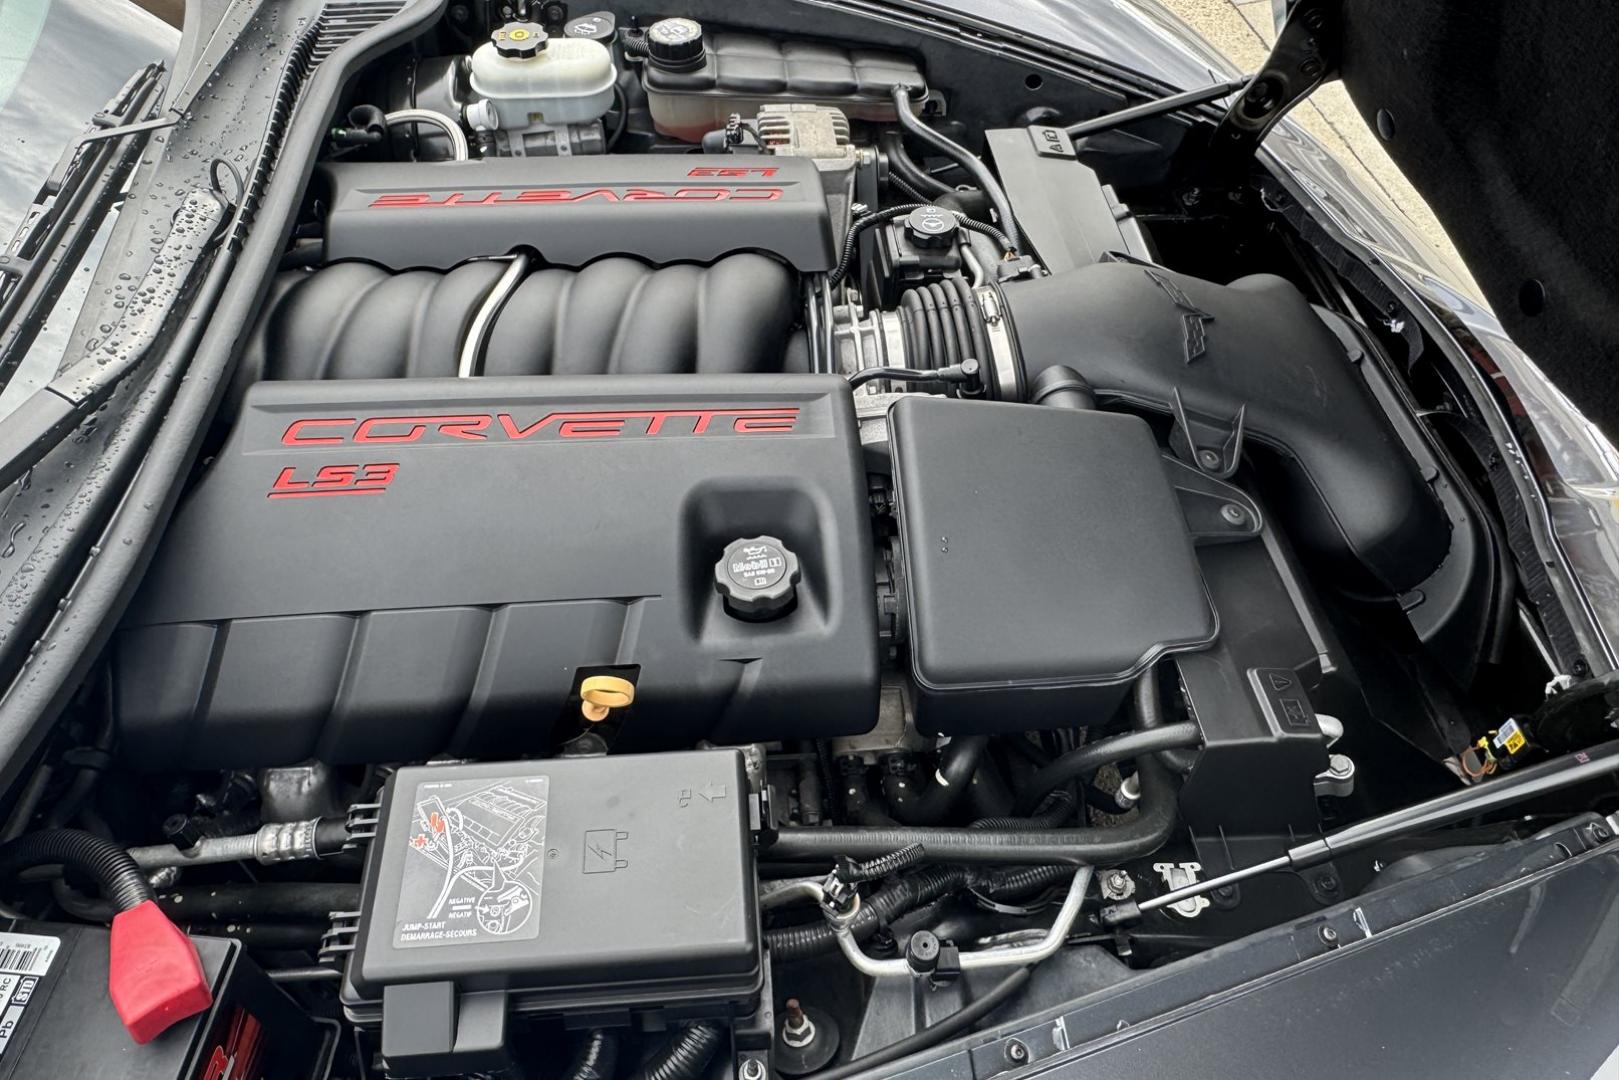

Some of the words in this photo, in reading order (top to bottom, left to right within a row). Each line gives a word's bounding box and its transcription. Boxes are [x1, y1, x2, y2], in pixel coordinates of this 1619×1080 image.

[368, 188, 784, 208] CORVETTE
[281, 407, 800, 446] CORVETTE
[267, 462, 400, 498] LS3
[448, 897, 476, 905] NEGATIVE
[402, 921, 446, 932] JUMP-START
